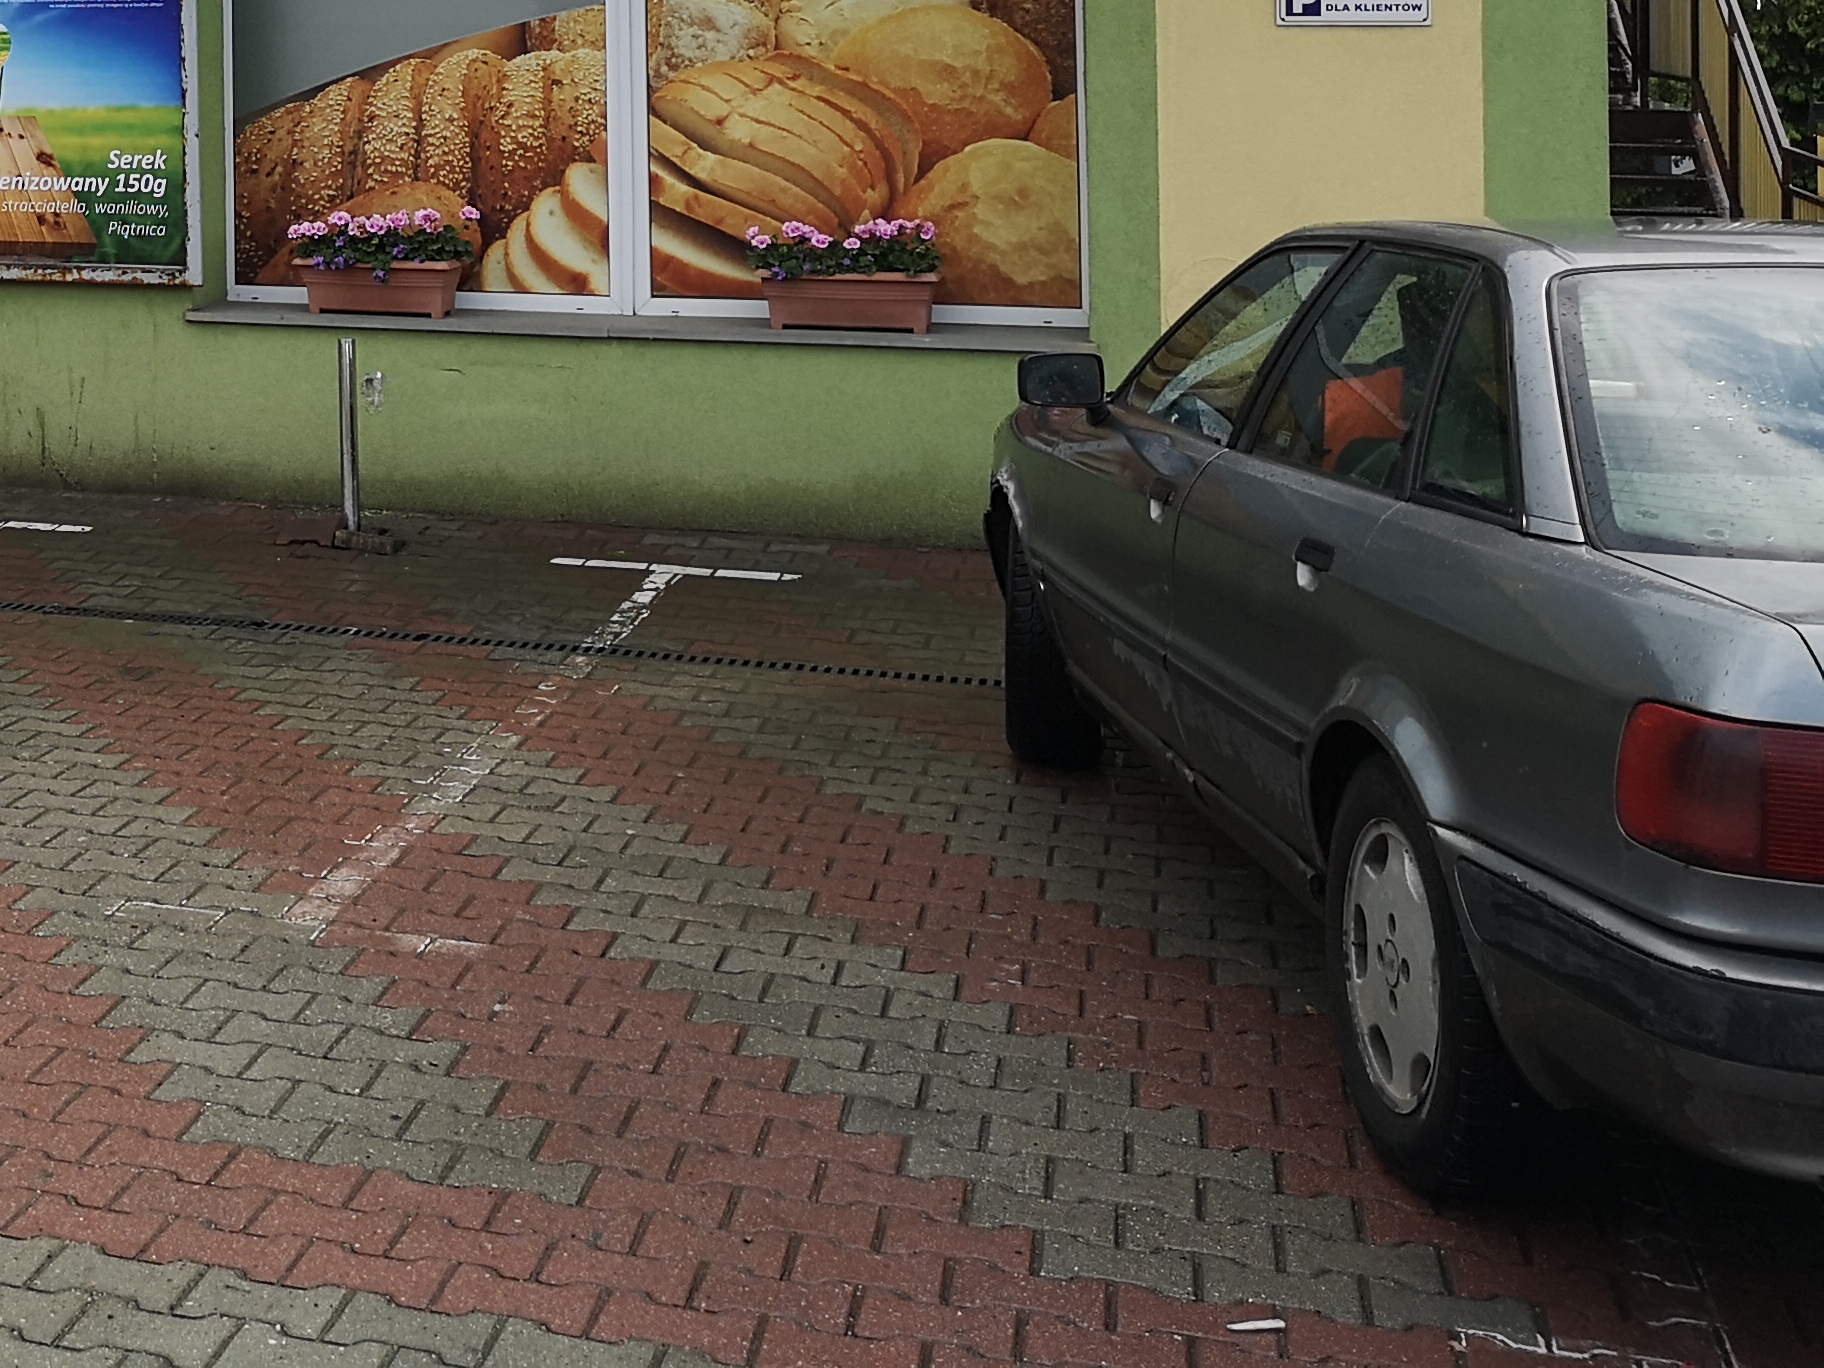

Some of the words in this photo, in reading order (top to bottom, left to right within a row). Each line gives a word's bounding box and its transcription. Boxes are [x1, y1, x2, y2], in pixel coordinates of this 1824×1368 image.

[1325, 3, 1351, 12] DLA
[1354, 2, 1423, 12] KLIENTÓW
[107, 149, 167, 170] Serek
[114, 173, 167, 197] 150g
[1, 199, 90, 216] stracciatella,
[94, 200, 169, 219] waniliowy,
[108, 221, 166, 239] Piątnica
